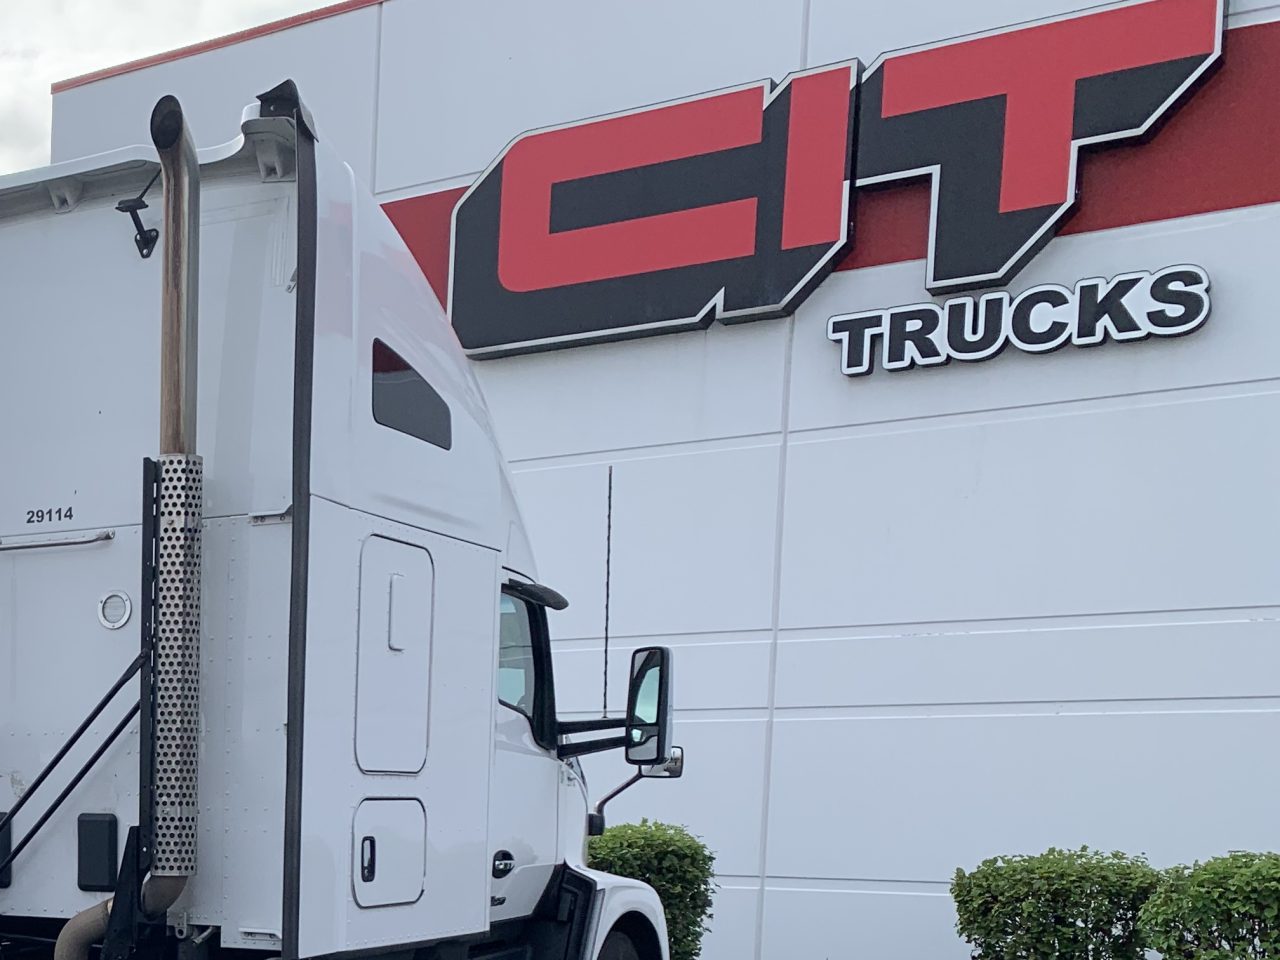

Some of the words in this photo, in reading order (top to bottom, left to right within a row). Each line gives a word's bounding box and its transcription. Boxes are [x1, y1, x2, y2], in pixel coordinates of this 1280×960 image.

[455, 0, 1222, 345] CIT
[828, 266, 1212, 375] TRUCKS
[26, 506, 73, 524] 29114
